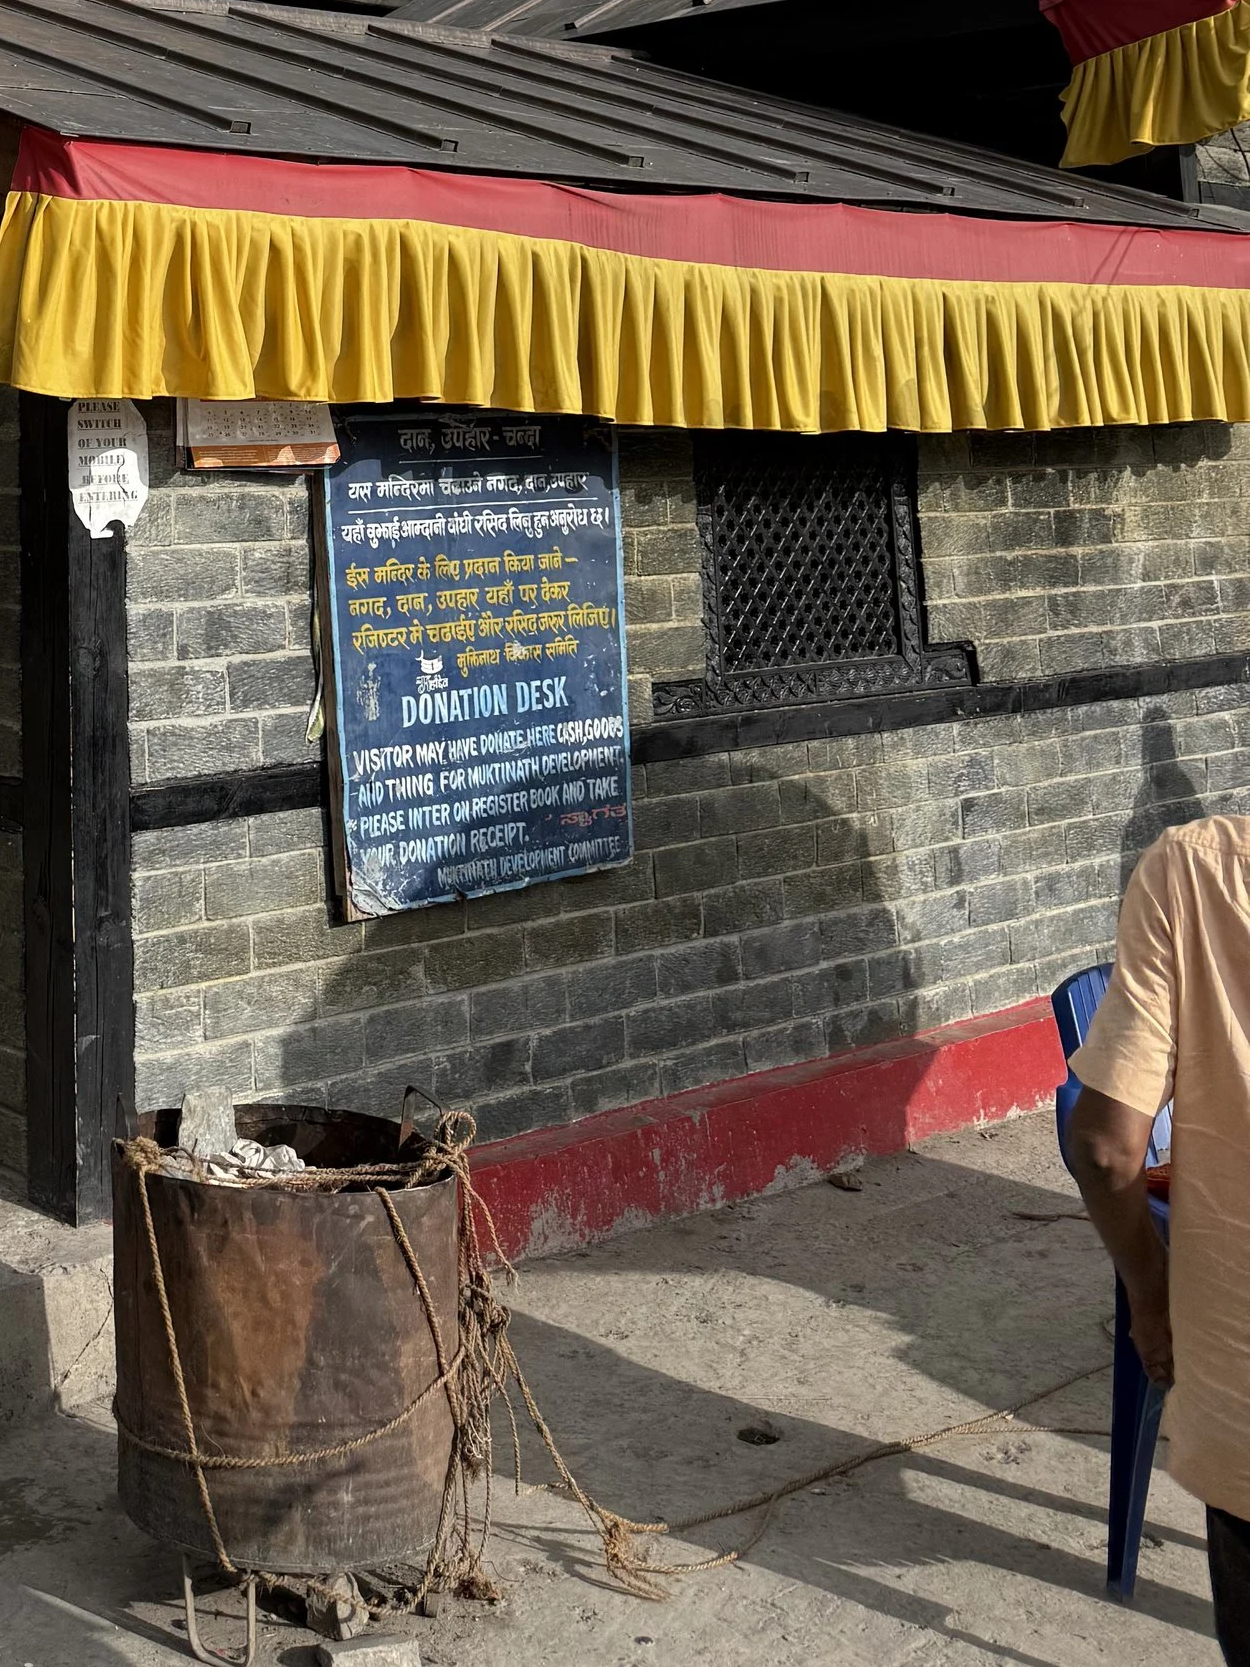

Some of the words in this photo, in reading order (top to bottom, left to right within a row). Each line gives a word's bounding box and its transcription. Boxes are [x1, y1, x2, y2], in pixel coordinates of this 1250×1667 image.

[78, 401, 120, 412] PLEASE
[77, 418, 121, 428] SWITCH
[78, 438, 93, 449] OF
[95, 437, 127, 448] YOUR
[78, 454, 124, 465] MOBILE
[348, 482, 373, 503] यस
[375, 474, 435, 501] मन्दिरमा
[341, 518, 365, 544] यहाँ
[374, 558, 415, 586] मन्दिर
[417, 556, 431, 581] के
[434, 554, 460, 581] लिए
[463, 557, 501, 580] प्रदान
[503, 550, 535, 575] किया
[436, 588, 480, 611] उपहार
[485, 579, 514, 606] यहाँ
[518, 584, 538, 606] पर
[541, 576, 571, 604] देकर
[478, 610, 504, 639] और
[545, 634, 579, 661] समिति
[401, 683, 508, 728] DONATION
[515, 676, 569, 713] DESK
[353, 745, 414, 776] VISITOR
[416, 741, 445, 766] MAY
[448, 736, 478, 761] HAVE
[527, 724, 556, 747] HERE
[358, 780, 384, 809] AND
[385, 773, 434, 803] THING
[440, 768, 467, 793] FOR
[468, 756, 540, 789] MUKTINATH
[360, 810, 405, 840] PLEASE
[409, 803, 450, 830] INTER
[453, 800, 470, 823] ON
[472, 791, 529, 821] REGISTER
[530, 785, 560, 809] BOOK
[563, 780, 585, 806] AND
[586, 776, 619, 801] TAKE
[399, 833, 466, 865] DONATION
[500, 846, 566, 876] DEVELOPMENT
[568, 836, 620, 862] COMMITTEE
